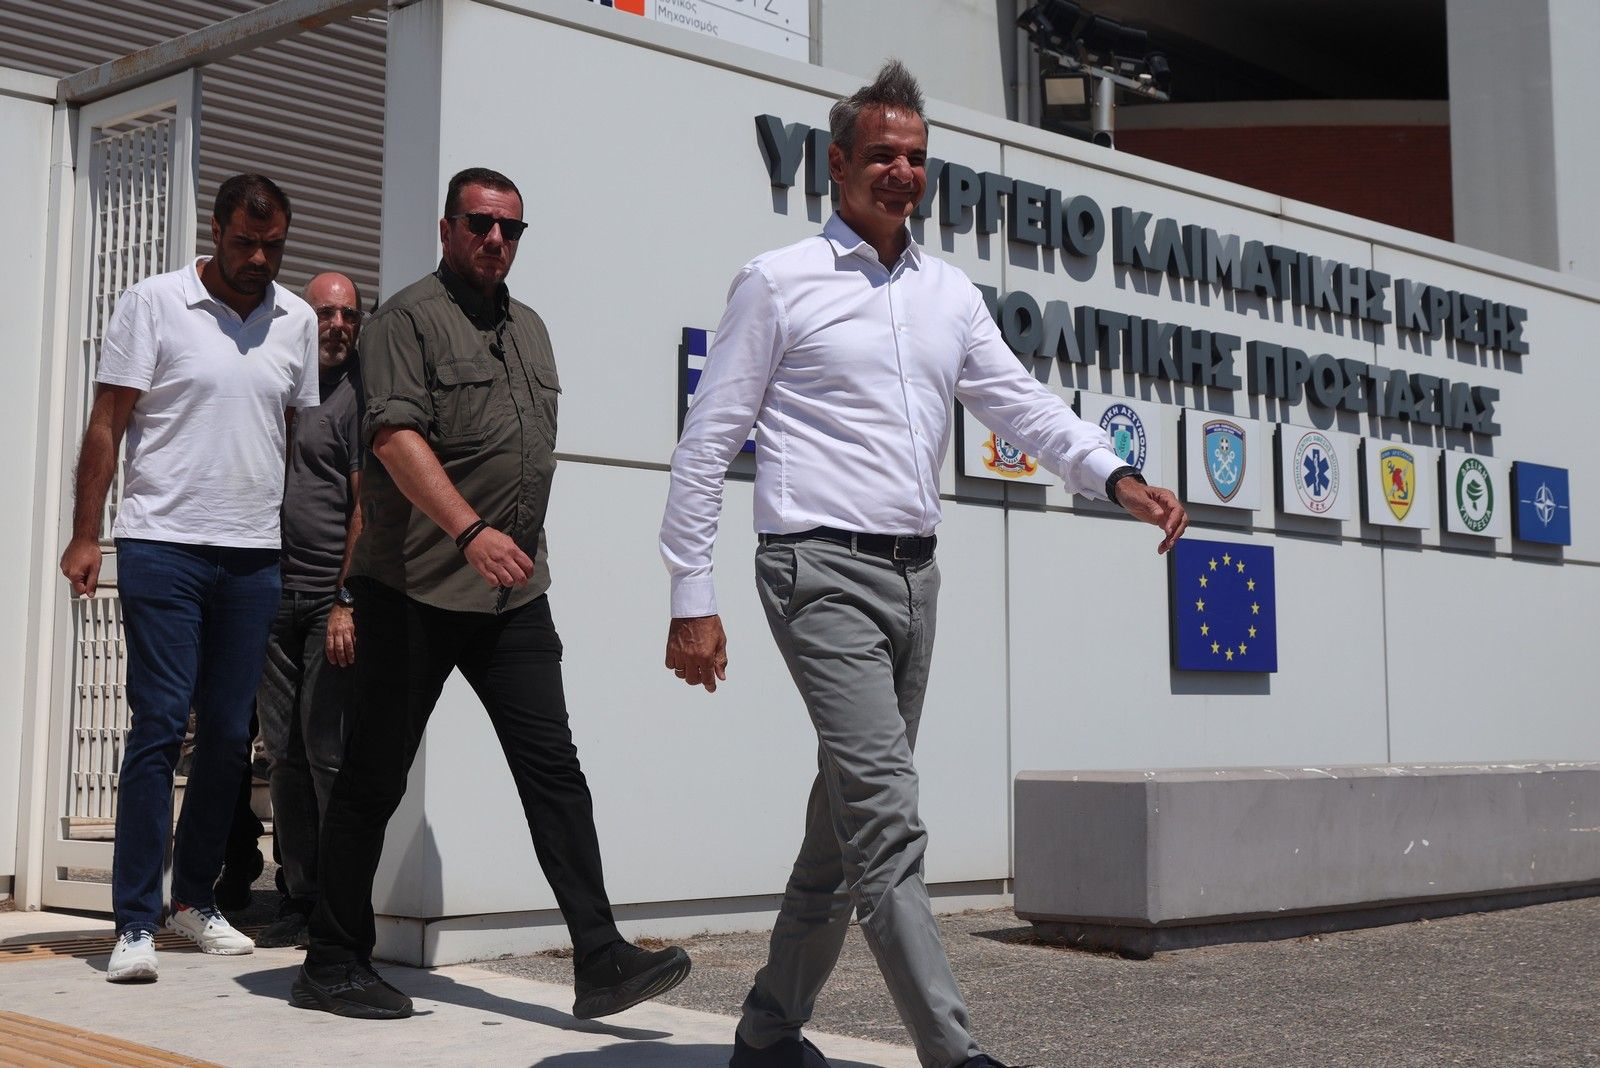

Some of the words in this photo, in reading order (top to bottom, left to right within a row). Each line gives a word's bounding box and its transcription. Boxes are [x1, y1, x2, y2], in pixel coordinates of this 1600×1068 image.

[658, 5, 719, 35] Μηχανισμός
[755, 114, 1105, 257] ΥΠΥΡΓΕΙΟ
[1112, 206, 1392, 325] ΚΛΙΜΑΤΙΚΗΣ
[1395, 278, 1530, 354] ΚΡΙΣΗΣ
[1247, 340, 1501, 436] ΠΡΟΣΤΑΣΙΑΣ
[1101, 406, 1119, 429] ΝΙΚΗ
[1121, 406, 1146, 470] ΑΣΤΥΝΟΜΙΑ
